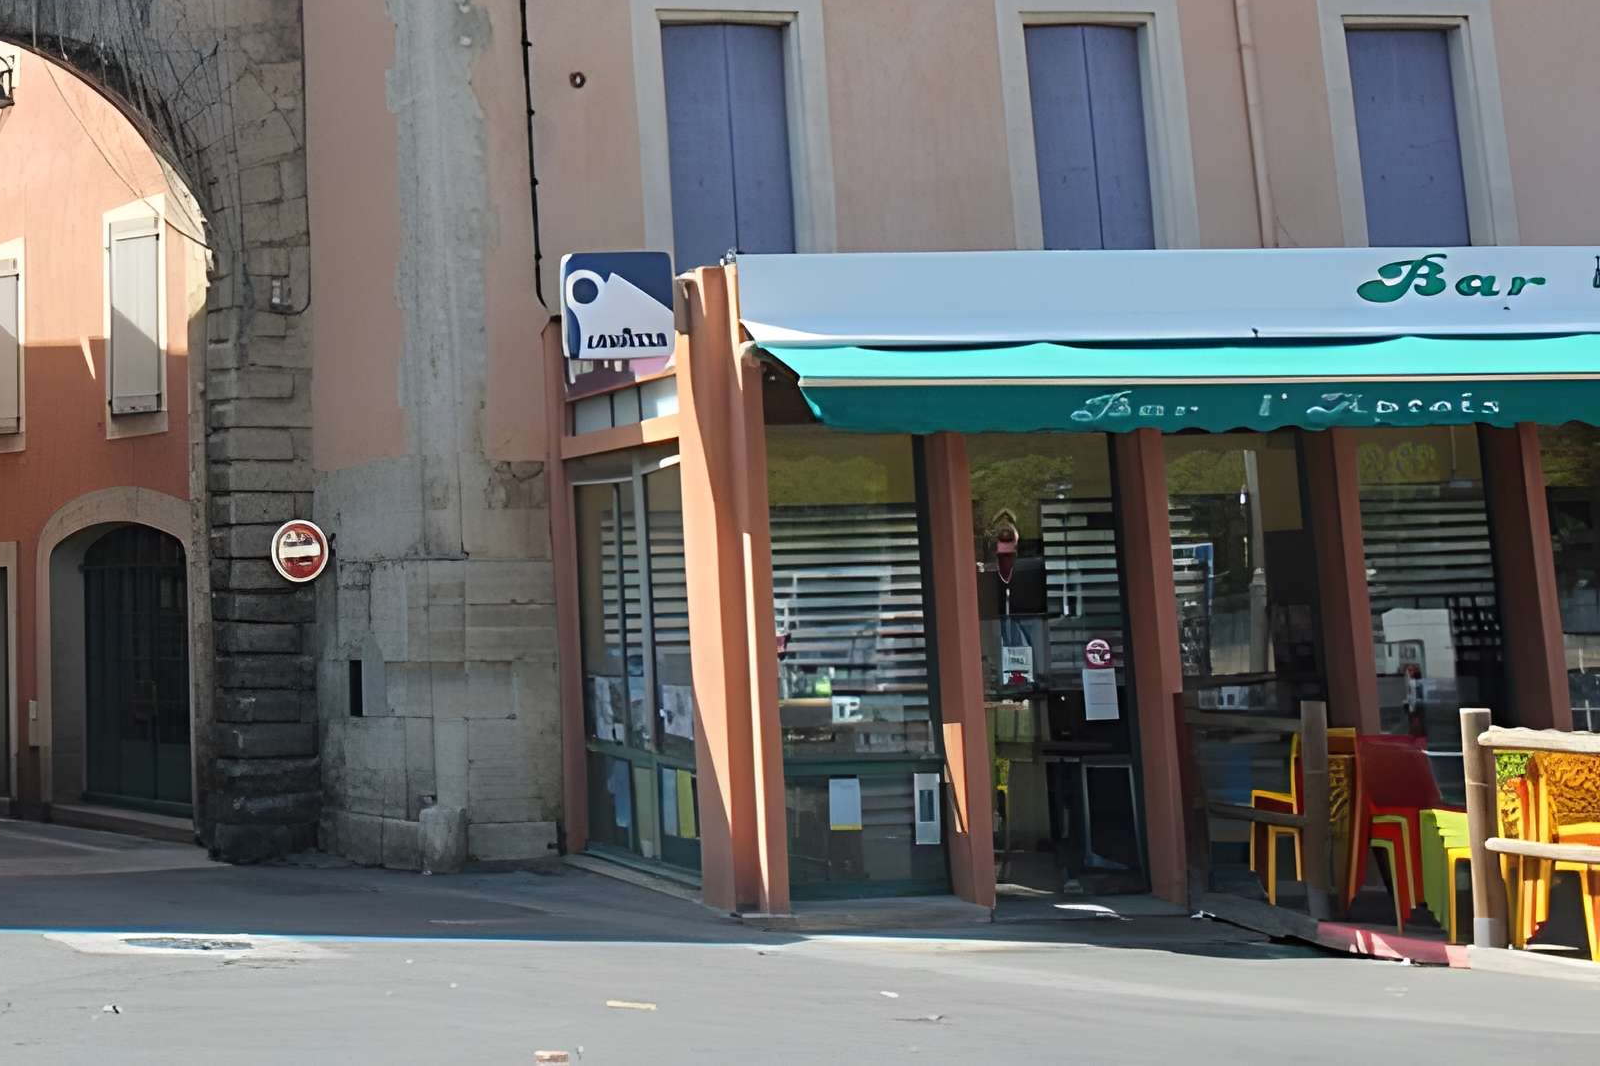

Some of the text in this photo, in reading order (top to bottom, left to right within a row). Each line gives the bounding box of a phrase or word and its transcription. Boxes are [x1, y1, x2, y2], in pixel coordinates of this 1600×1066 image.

[1357, 254, 1546, 303] Bar
[587, 328, 668, 349] LAVAZZA
[1071, 390, 1199, 422] Bar
